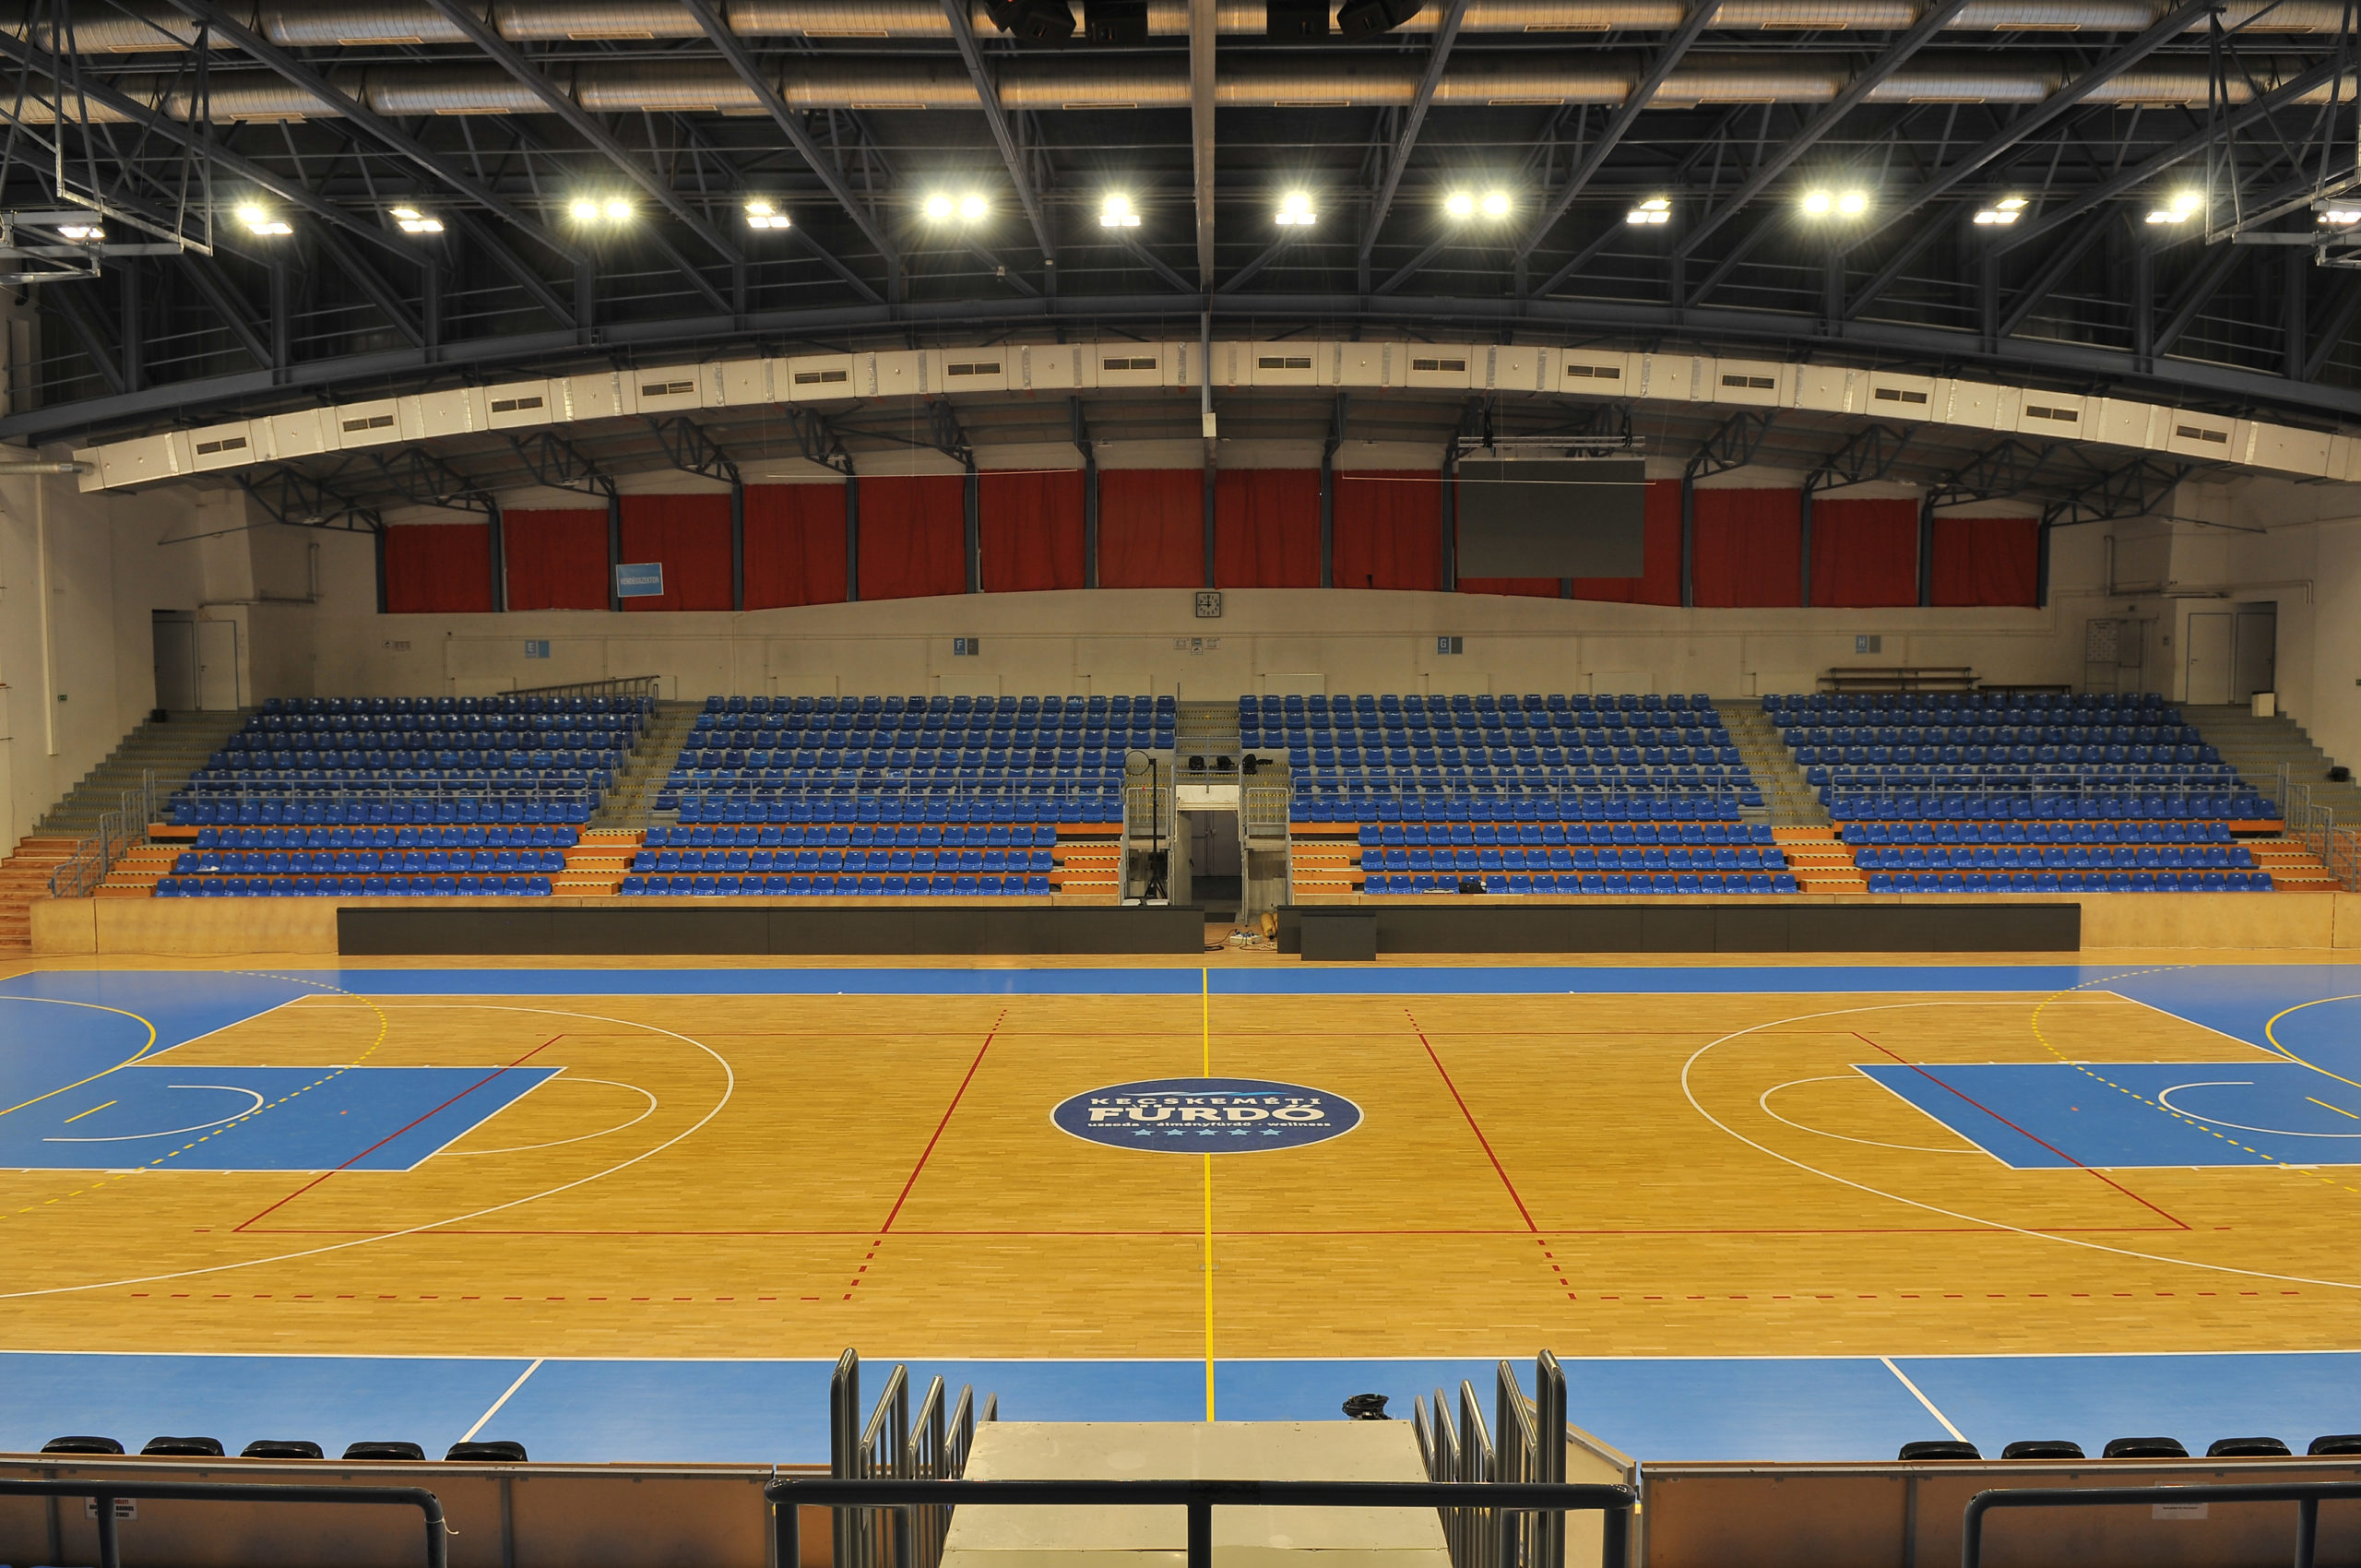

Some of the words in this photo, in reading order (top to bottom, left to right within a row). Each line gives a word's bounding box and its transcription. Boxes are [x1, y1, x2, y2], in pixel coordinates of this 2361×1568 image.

[528, 642, 535, 652] E
[956, 639, 963, 649] F
[1440, 638, 1447, 648] G
[1858, 637, 1866, 647] H
[1090, 1097, 1321, 1105] KECSKEMÉTI
[1088, 1104, 1325, 1122] FÜRDŐ
